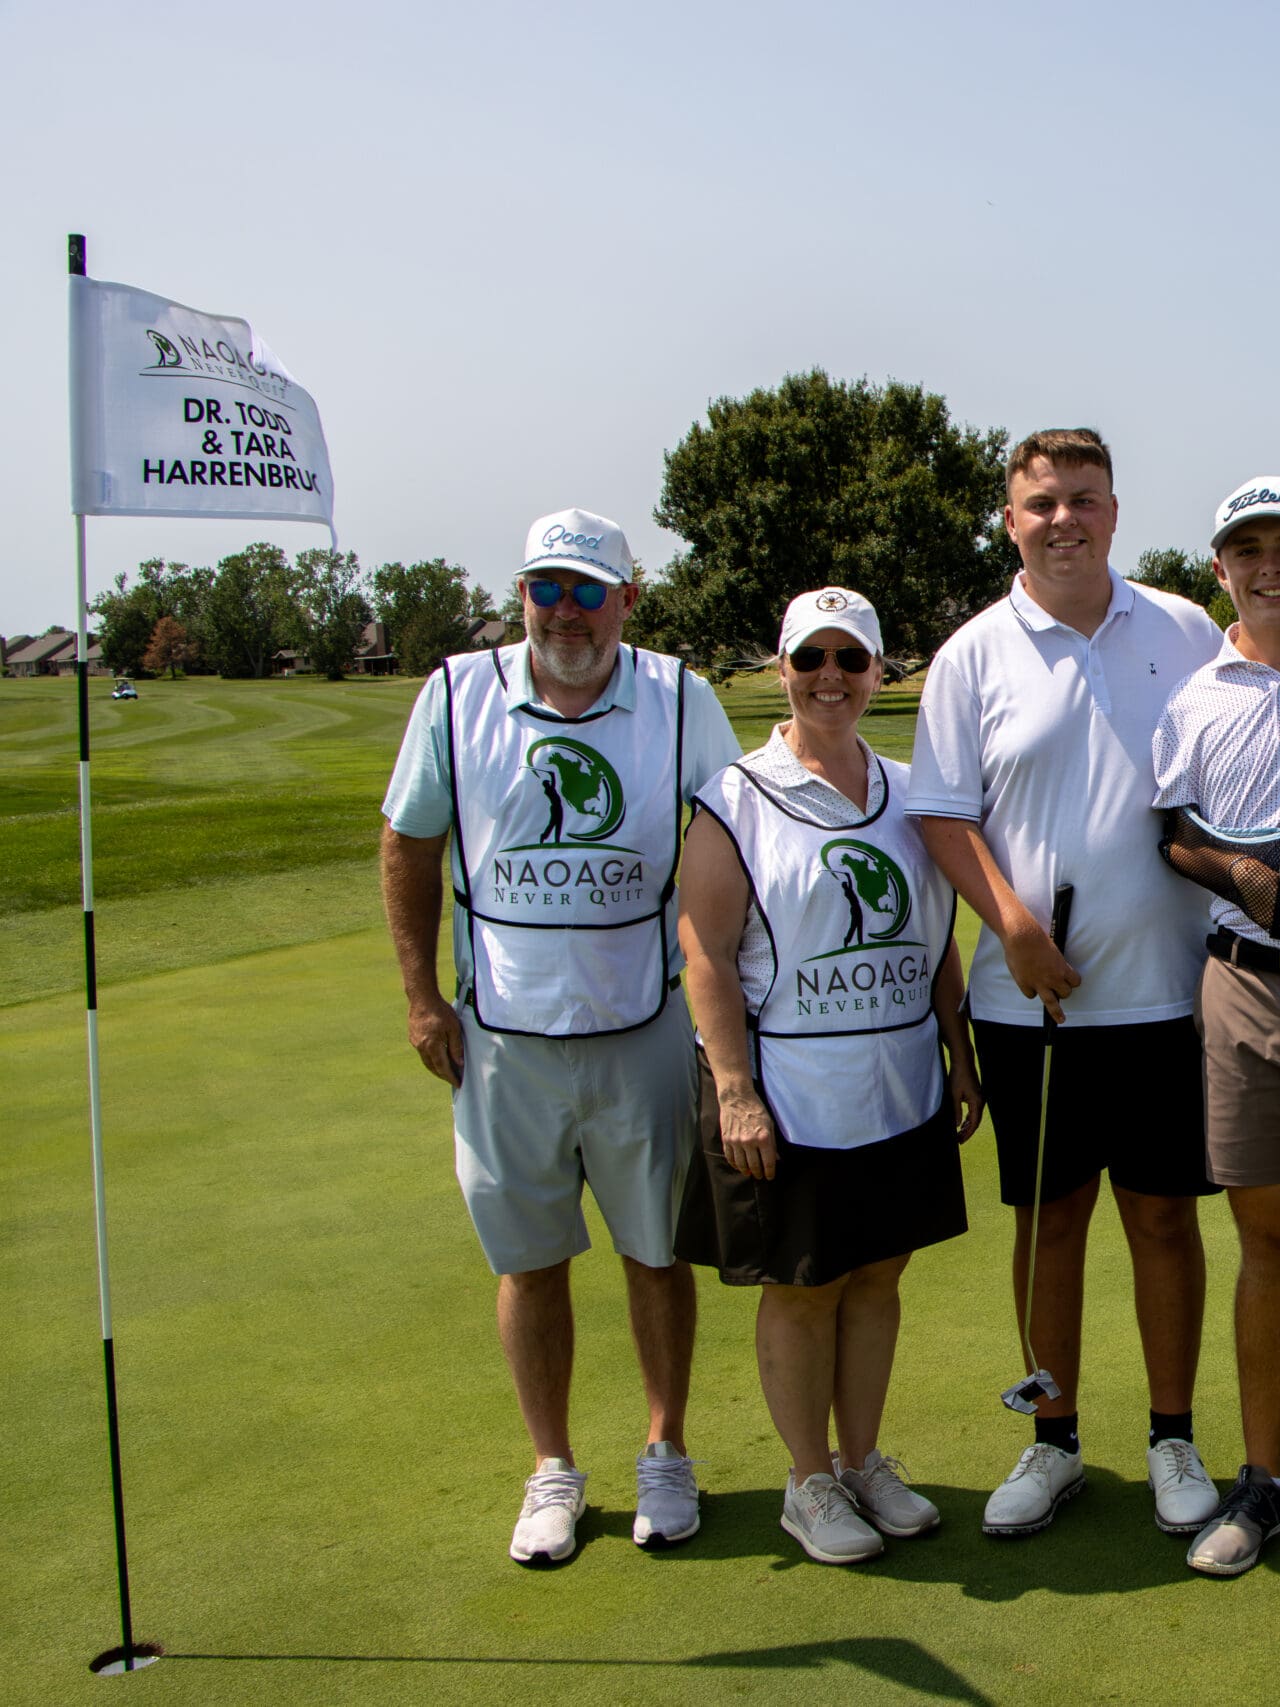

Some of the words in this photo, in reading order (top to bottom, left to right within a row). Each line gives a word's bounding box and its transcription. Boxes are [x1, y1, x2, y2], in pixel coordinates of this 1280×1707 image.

[183, 397, 231, 424] DR.
[234, 401, 293, 436] TODD
[201, 429, 223, 455] &
[230, 430, 297, 462] TARA
[494, 858, 644, 888] NAOAGA
[494, 887, 573, 905] NEVER
[589, 887, 644, 909] QUIT
[796, 953, 930, 998] NAOAGA
[797, 995, 882, 1017] NEVER
[892, 985, 930, 1008] QUIT
